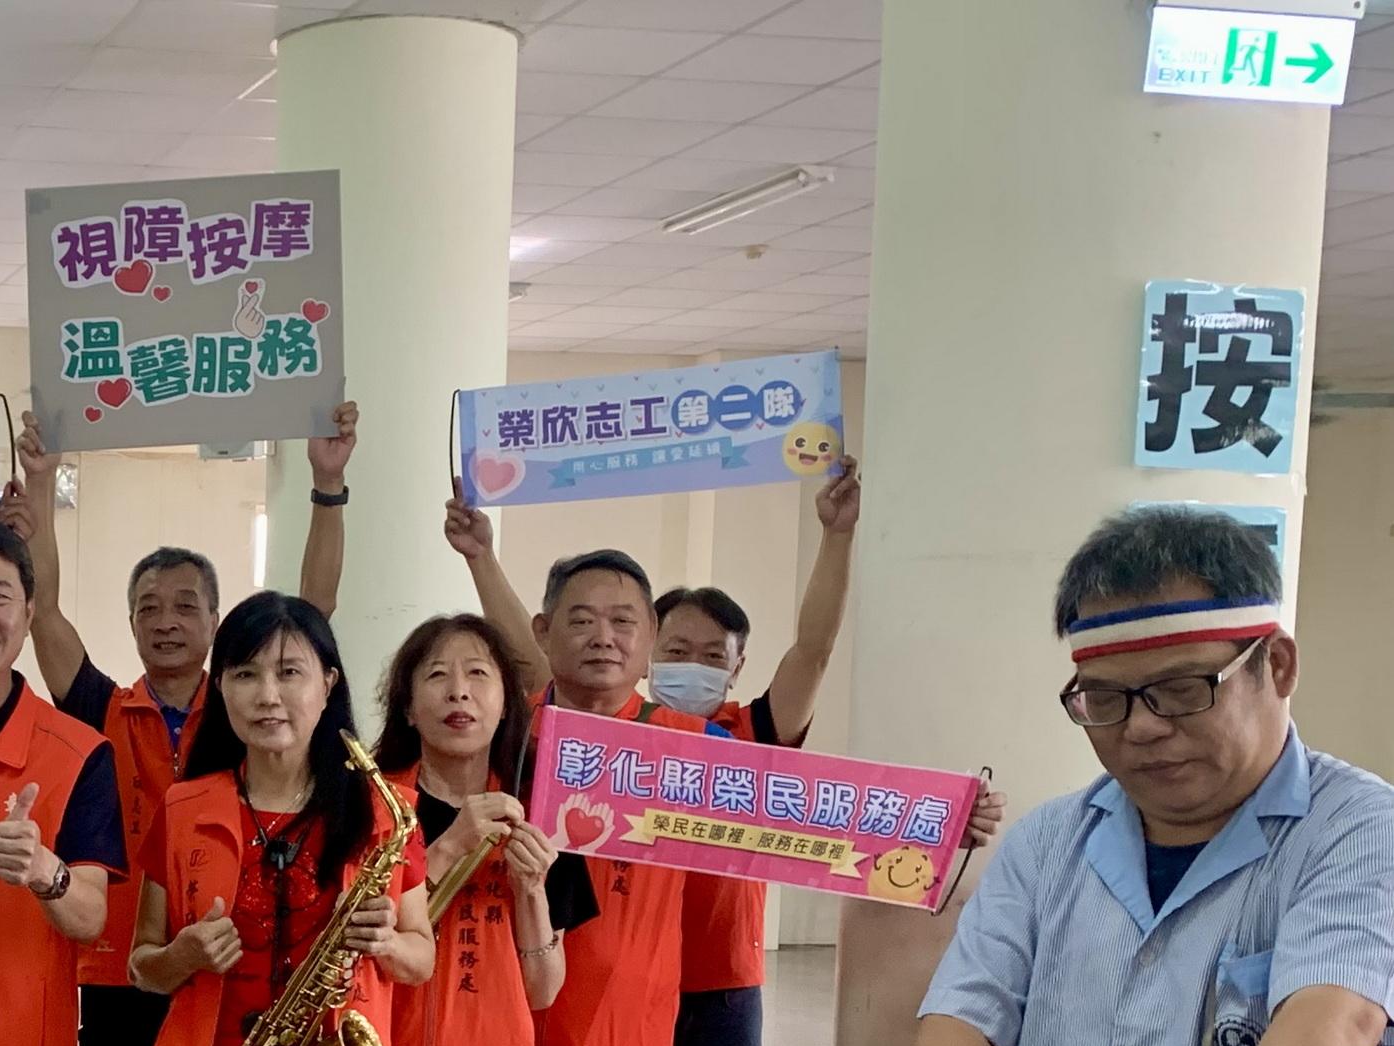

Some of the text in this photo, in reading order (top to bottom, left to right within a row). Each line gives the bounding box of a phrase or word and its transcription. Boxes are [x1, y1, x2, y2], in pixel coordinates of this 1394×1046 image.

[1158, 67, 1211, 84] EXIT
[57, 200, 312, 282] 視障按摩
[63, 316, 318, 404] 溫馨服務
[1144, 292, 1293, 458] 按
[497, 384, 802, 449] 榮欣志工第二隊
[556, 738, 951, 845] 彰化縣榮民服務處
